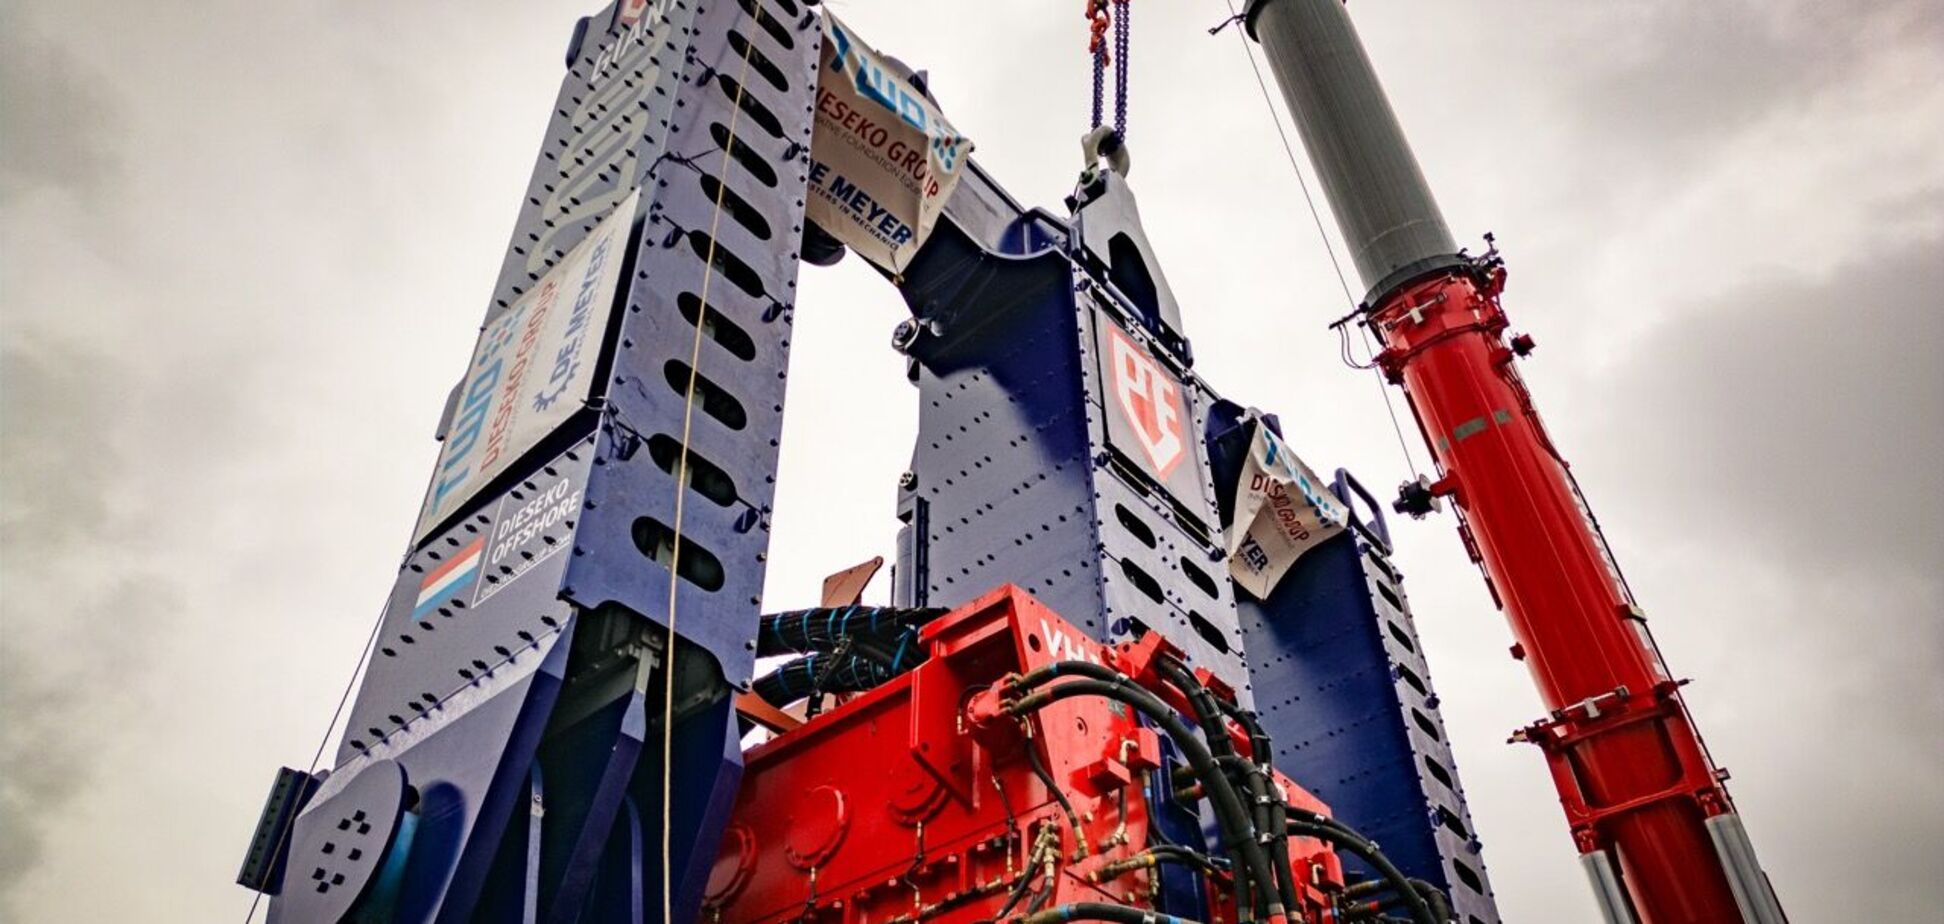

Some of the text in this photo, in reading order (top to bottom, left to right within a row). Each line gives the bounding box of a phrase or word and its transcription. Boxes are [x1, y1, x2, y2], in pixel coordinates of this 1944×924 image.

[815, 87, 888, 148] IESEKO
[829, 175, 912, 244] MEYER
[839, 203, 851, 215] IN
[550, 336, 578, 385] DE
[564, 236, 608, 338] MEYER
[481, 357, 528, 473] DIESEKO
[516, 281, 557, 359] GROUP
[491, 489, 581, 565] OFFSHORE
[498, 477, 570, 541] DIESEKO
[1240, 530, 1269, 571] YER
